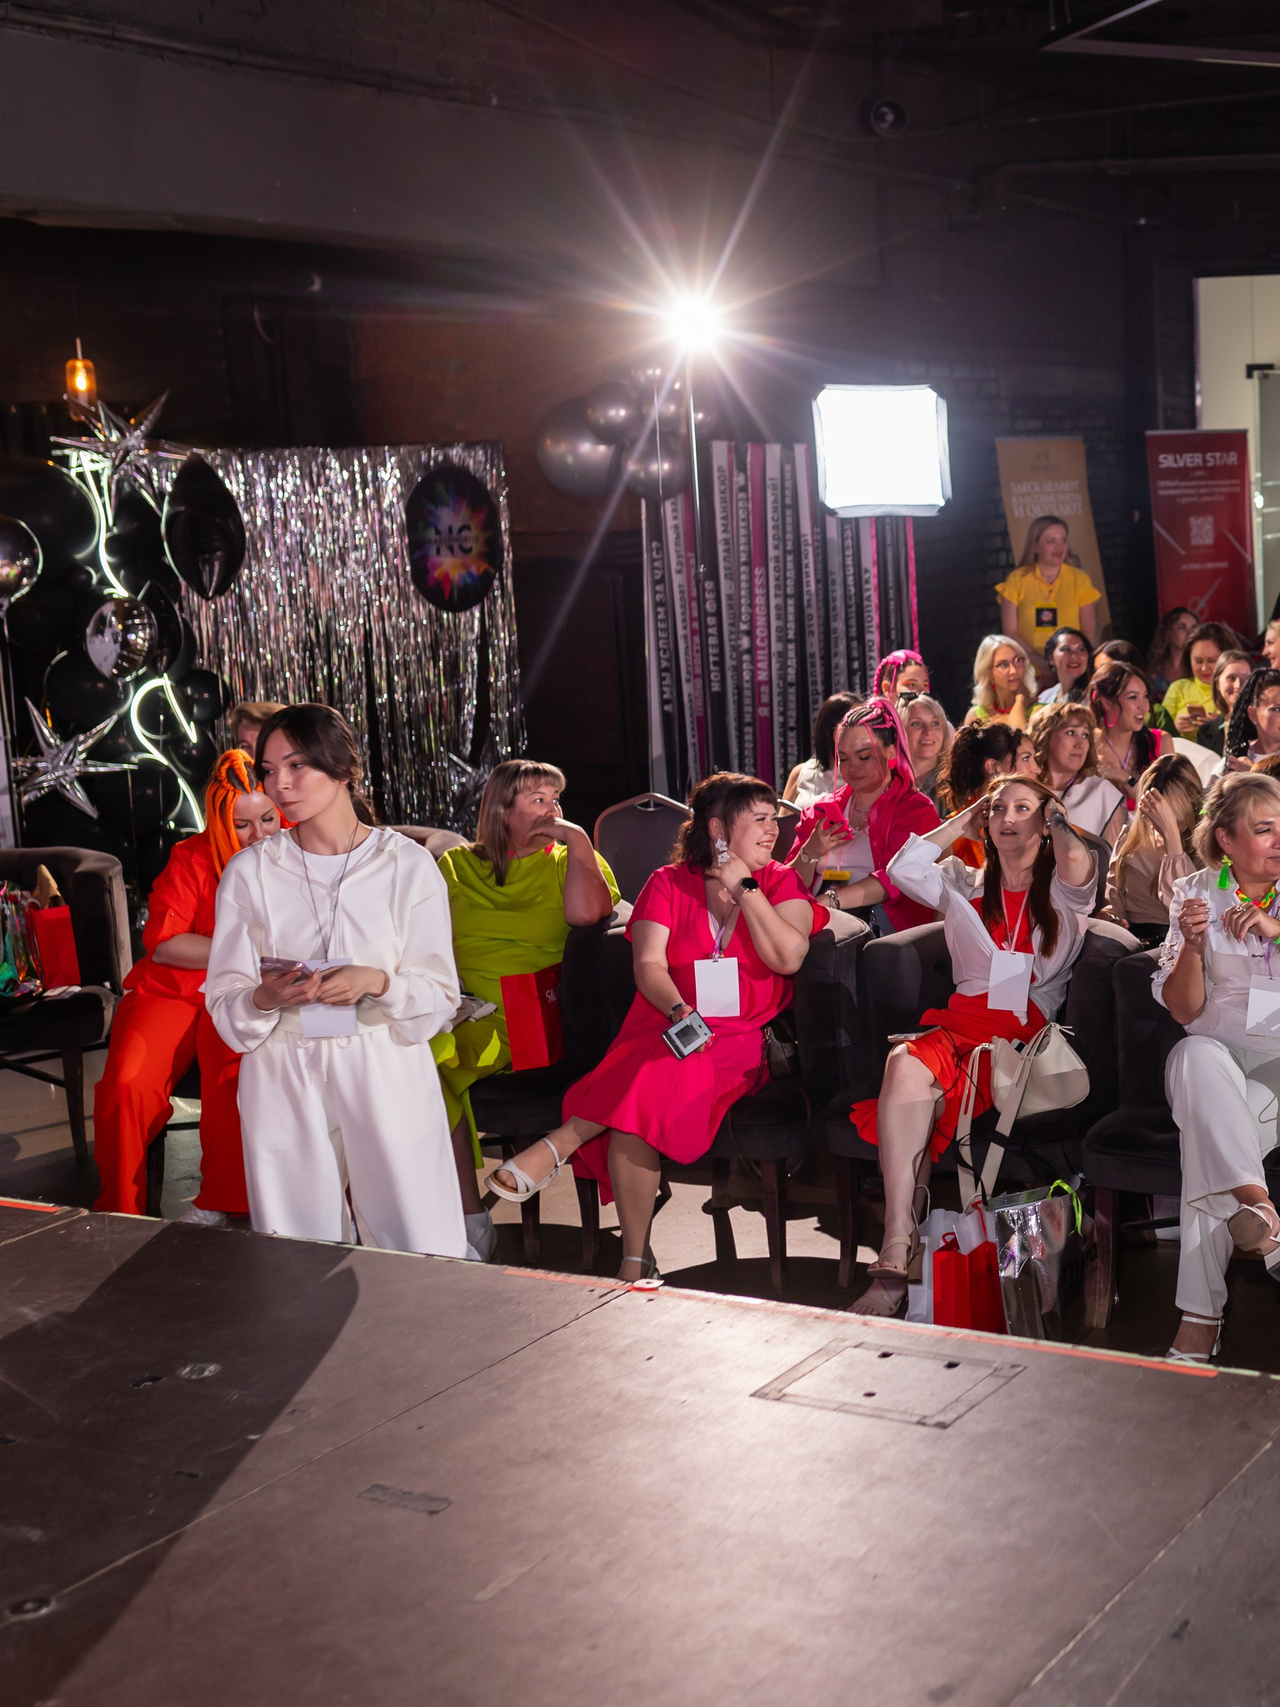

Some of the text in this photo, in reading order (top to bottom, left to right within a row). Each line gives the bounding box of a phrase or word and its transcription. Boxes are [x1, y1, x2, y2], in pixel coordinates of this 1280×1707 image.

[1158, 451, 1238, 468] SILVER STAR
[717, 465, 730, 534] МАНИКЮР
[738, 491, 749, 563] маникюра
[768, 477, 782, 551] красный!
[670, 523, 684, 575] Круглый
[718, 537, 733, 582] ДЕЛАЙ
[770, 555, 782, 599] такой
[785, 553, 796, 595] педик
[801, 534, 813, 608] маникюр!
[739, 565, 753, 631] Королева
[774, 603, 783, 621] не
[786, 597, 796, 640] маник
[806, 613, 815, 638] это
[862, 567, 874, 636] ЛОПАТКУ
[651, 540, 673, 713] А МЫ УСПЕЕМ ЗА ЧАС?
[704, 580, 722, 692] НОГТЕВАЯ ФЕЯ
[754, 566, 770, 717] Я на NAILCONGRESS
[775, 625, 784, 643] но
[741, 654, 754, 723] маникюра
[787, 642, 797, 683] педик
[808, 652, 822, 713] терапия
[787, 686, 797, 728] маник
